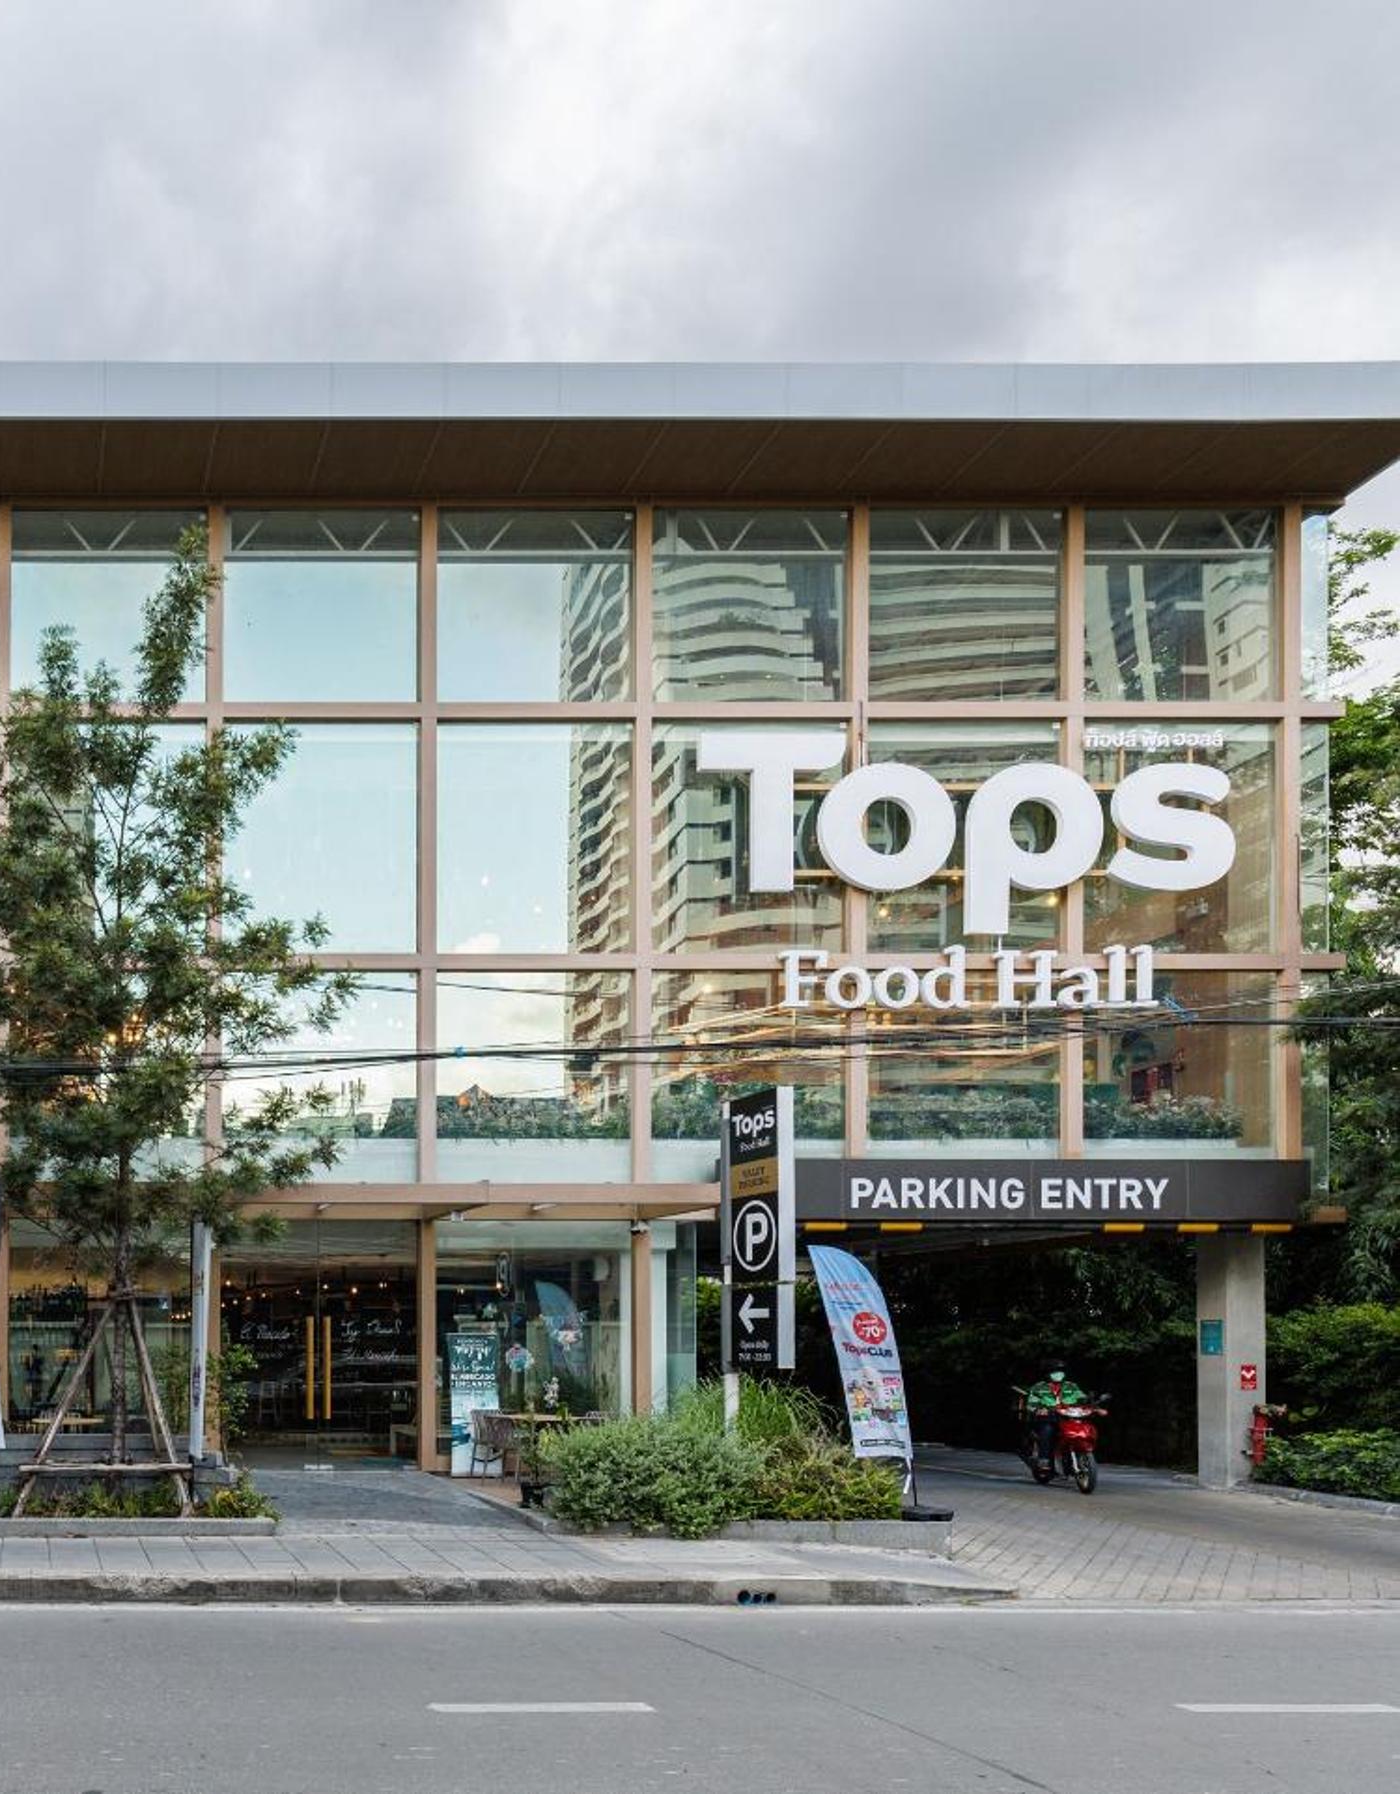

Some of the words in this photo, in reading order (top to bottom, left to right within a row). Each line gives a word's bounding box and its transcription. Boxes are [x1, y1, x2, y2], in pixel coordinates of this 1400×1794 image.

[697, 732, 1236, 935] Tops
[778, 944, 971, 1009] Food
[994, 943, 1160, 1009] Hall
[732, 1109, 775, 1138] Tops
[850, 1177, 1026, 1210] PARKING
[1040, 1177, 1170, 1210] ENTRY
[745, 1212, 769, 1262] P
